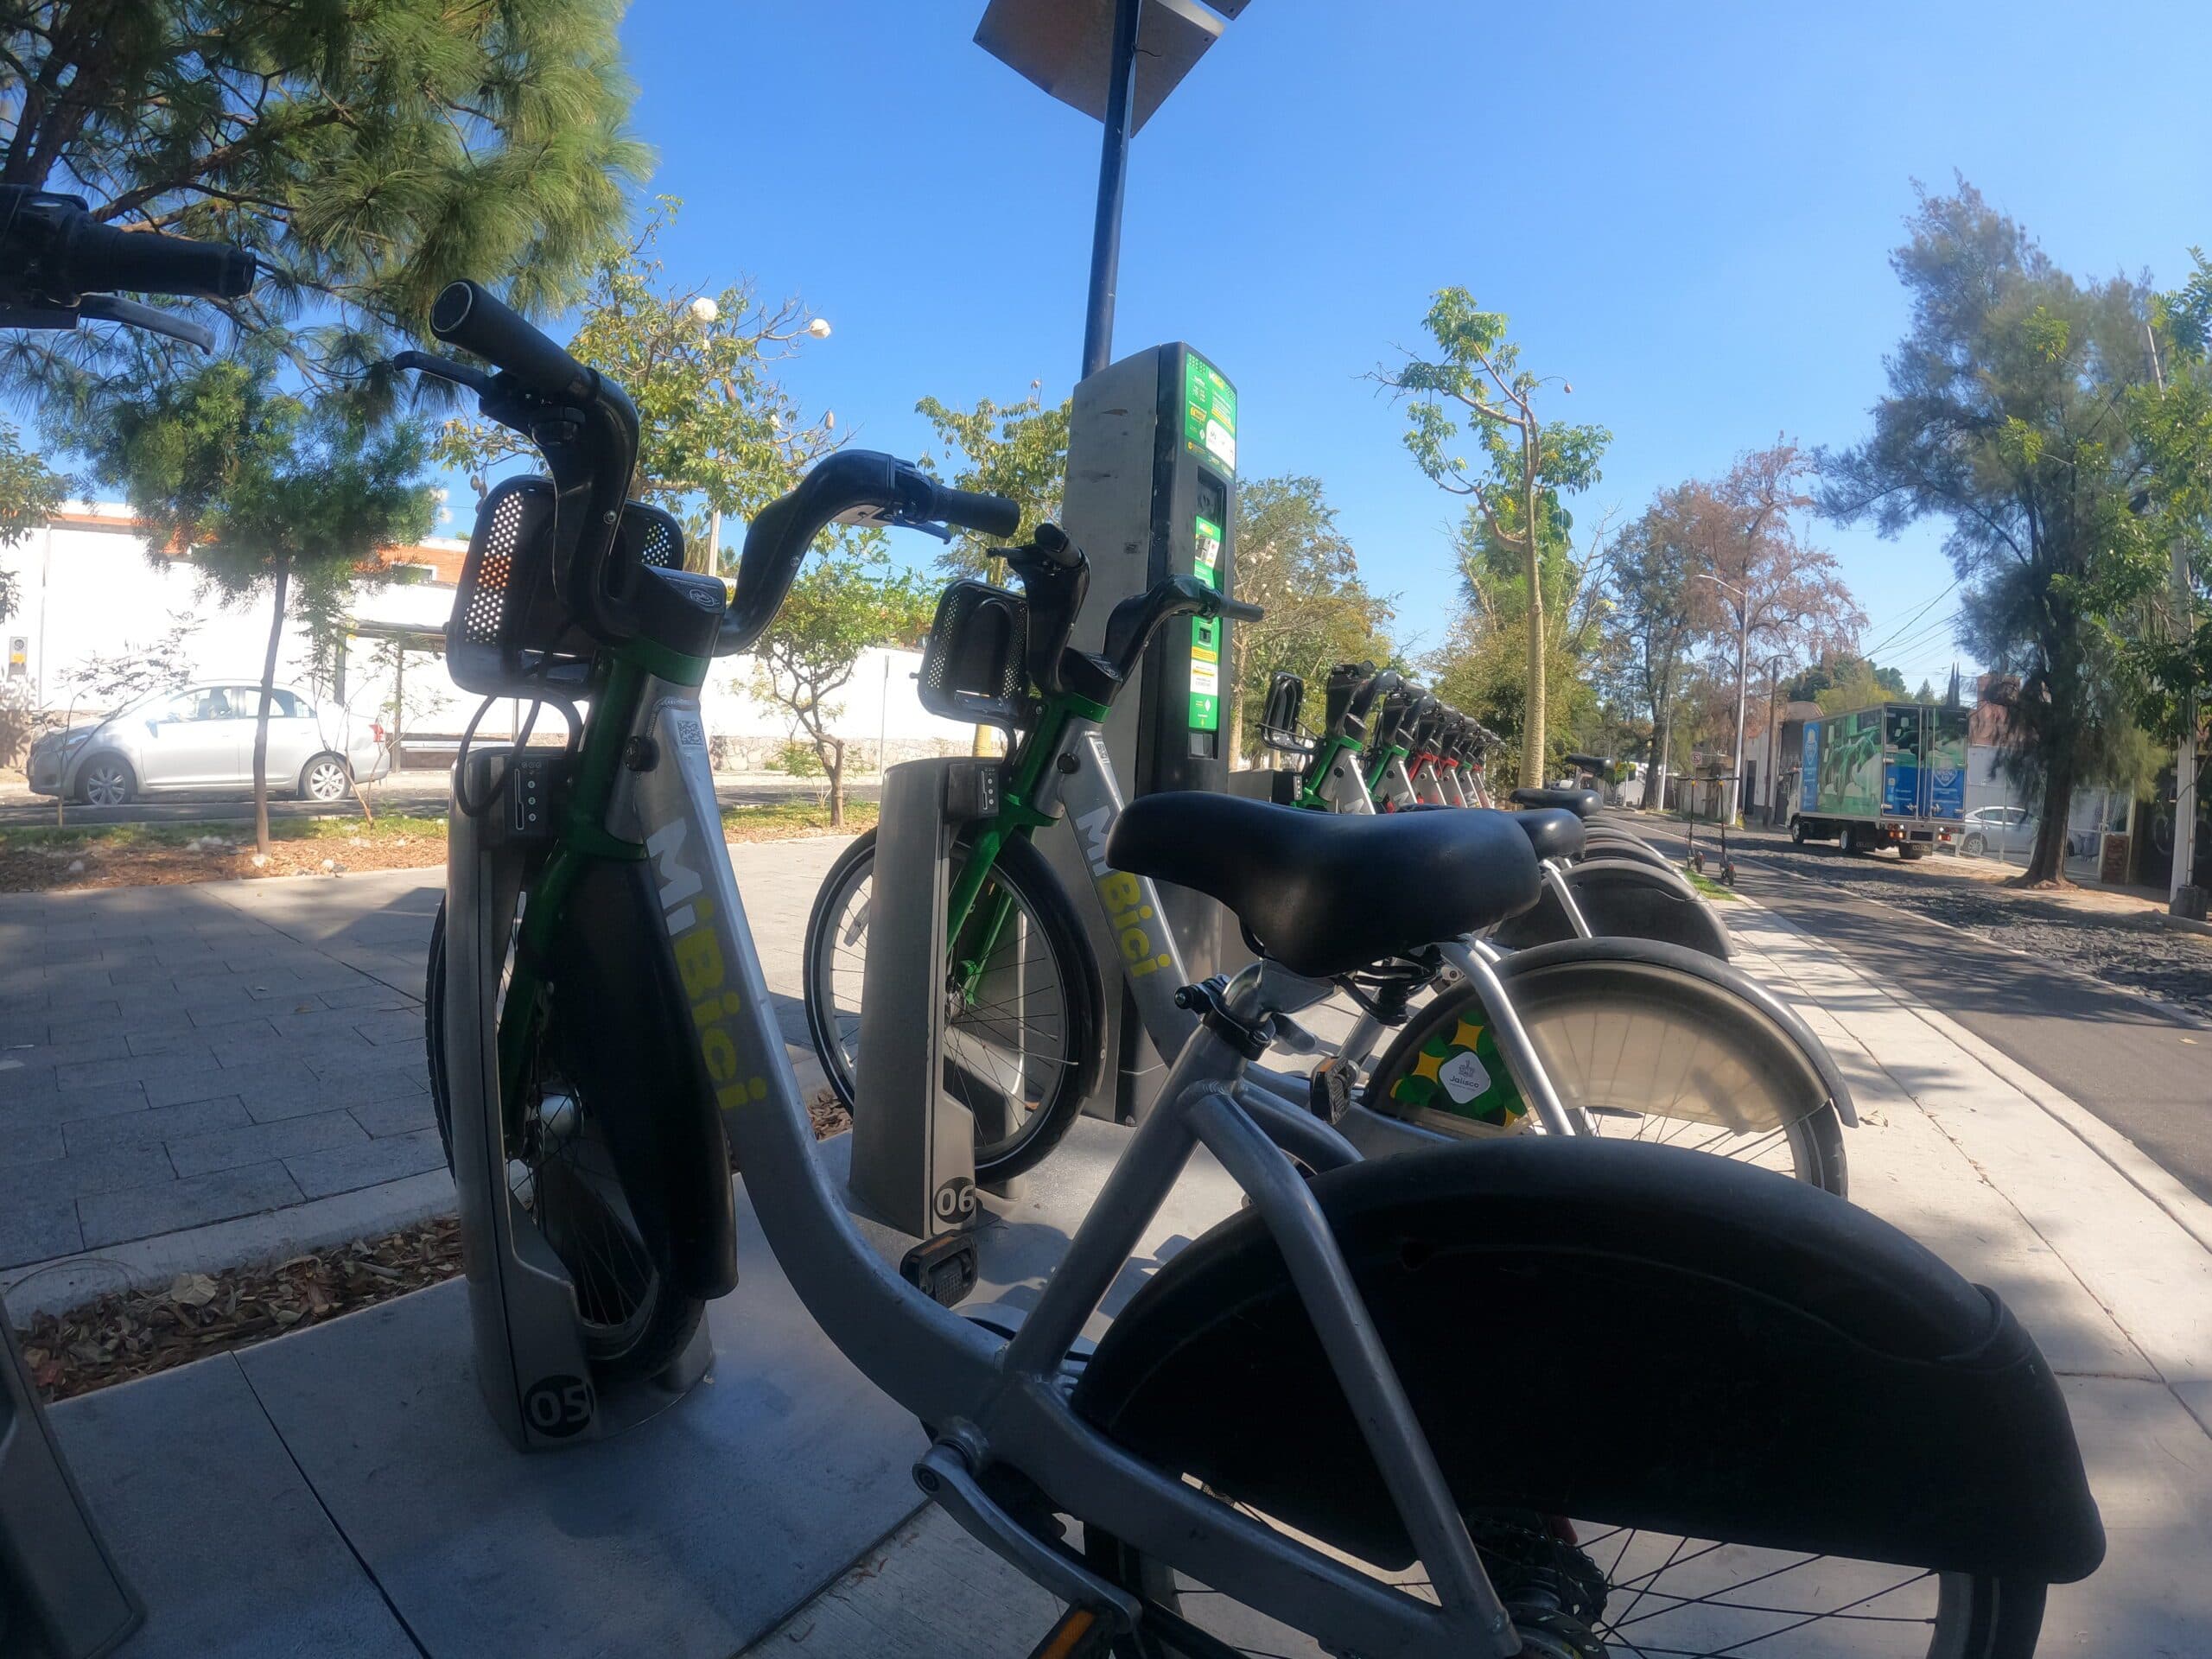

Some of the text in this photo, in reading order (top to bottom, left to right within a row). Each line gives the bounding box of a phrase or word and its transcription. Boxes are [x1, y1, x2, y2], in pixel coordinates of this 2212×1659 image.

[646, 817, 768, 1111] MiBici
[1450, 1076, 1479, 1089] Jalisco
[937, 1185, 976, 1217] 06
[531, 1384, 591, 1427] 05
